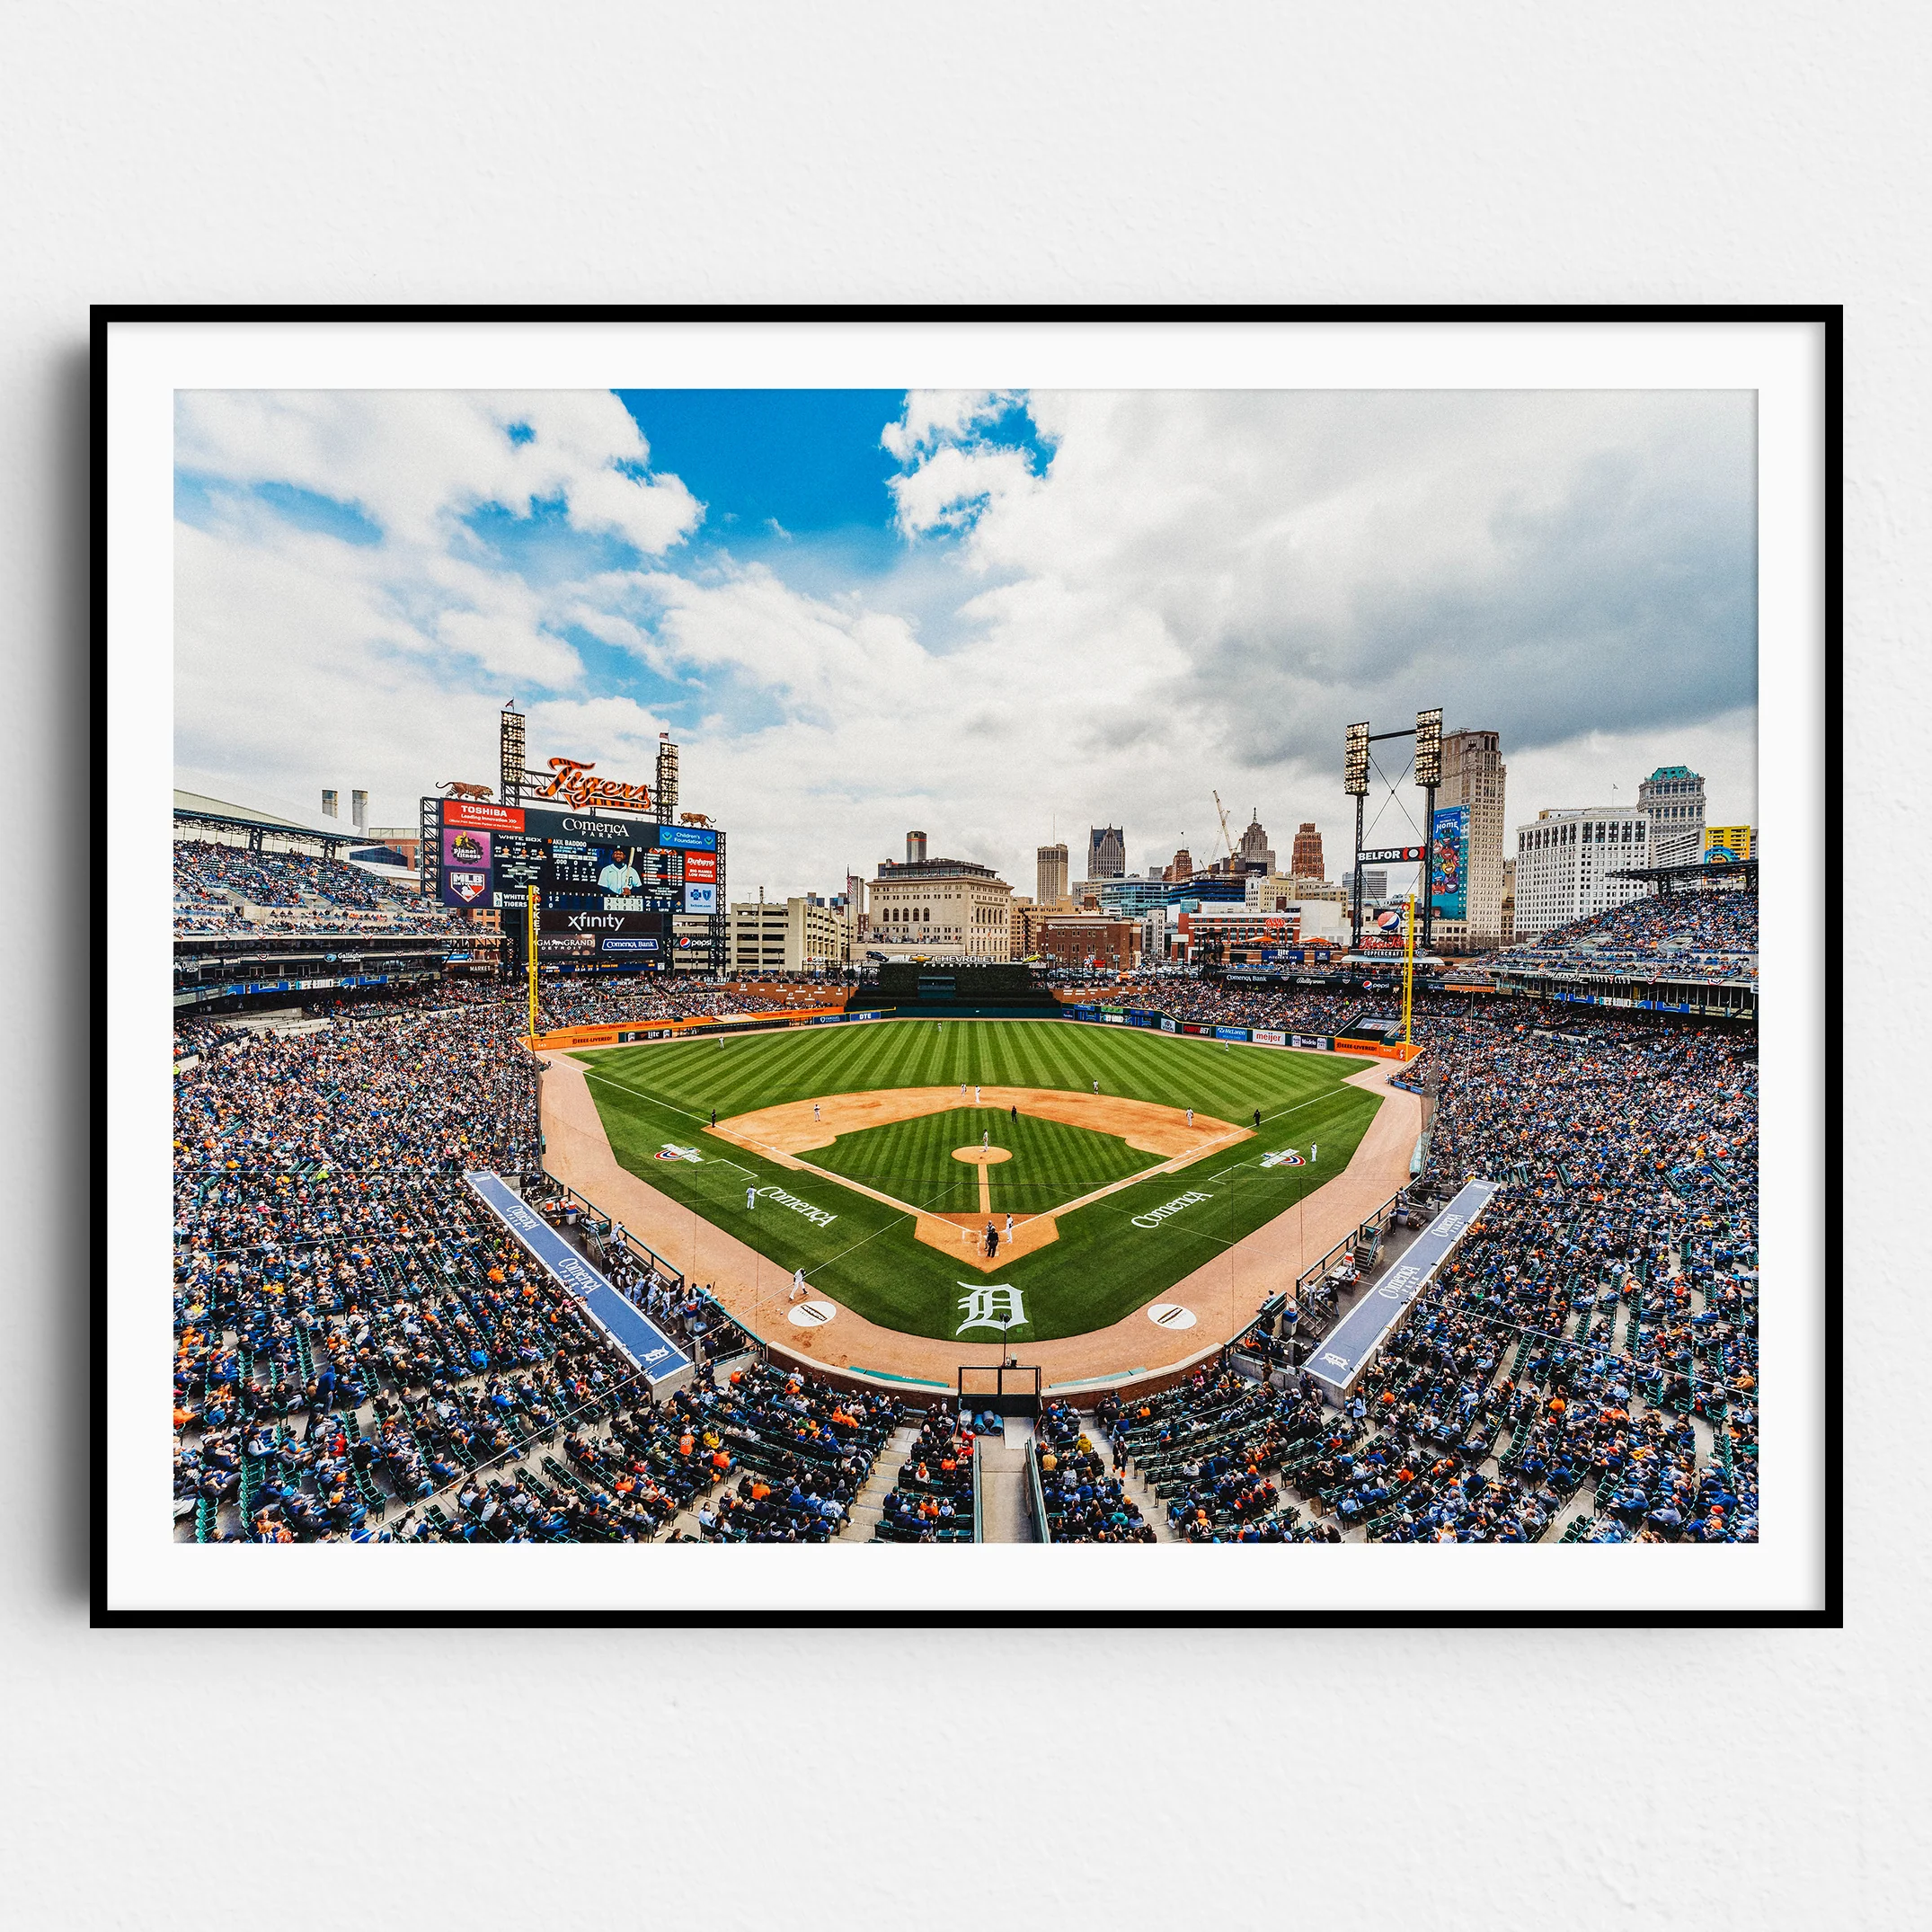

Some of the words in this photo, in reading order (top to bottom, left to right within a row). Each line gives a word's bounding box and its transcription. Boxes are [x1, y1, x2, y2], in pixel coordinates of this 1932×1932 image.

[535, 758, 651, 811] Tigers
[461, 805, 508, 817] TOSHIBA
[1435, 820, 1459, 833] HOME
[581, 830, 613, 838] PARK
[454, 847, 476, 855] planet
[1358, 850, 1400, 861] BELFOR
[454, 873, 483, 883] MLB
[568, 912, 625, 931] xfinity
[691, 939, 712, 947] pepsi
[648, 1031, 660, 1039] Lite
[1256, 1032, 1281, 1042] meijer
[559, 1269, 580, 1288] PARK
[1401, 1275, 1420, 1295] PARK
